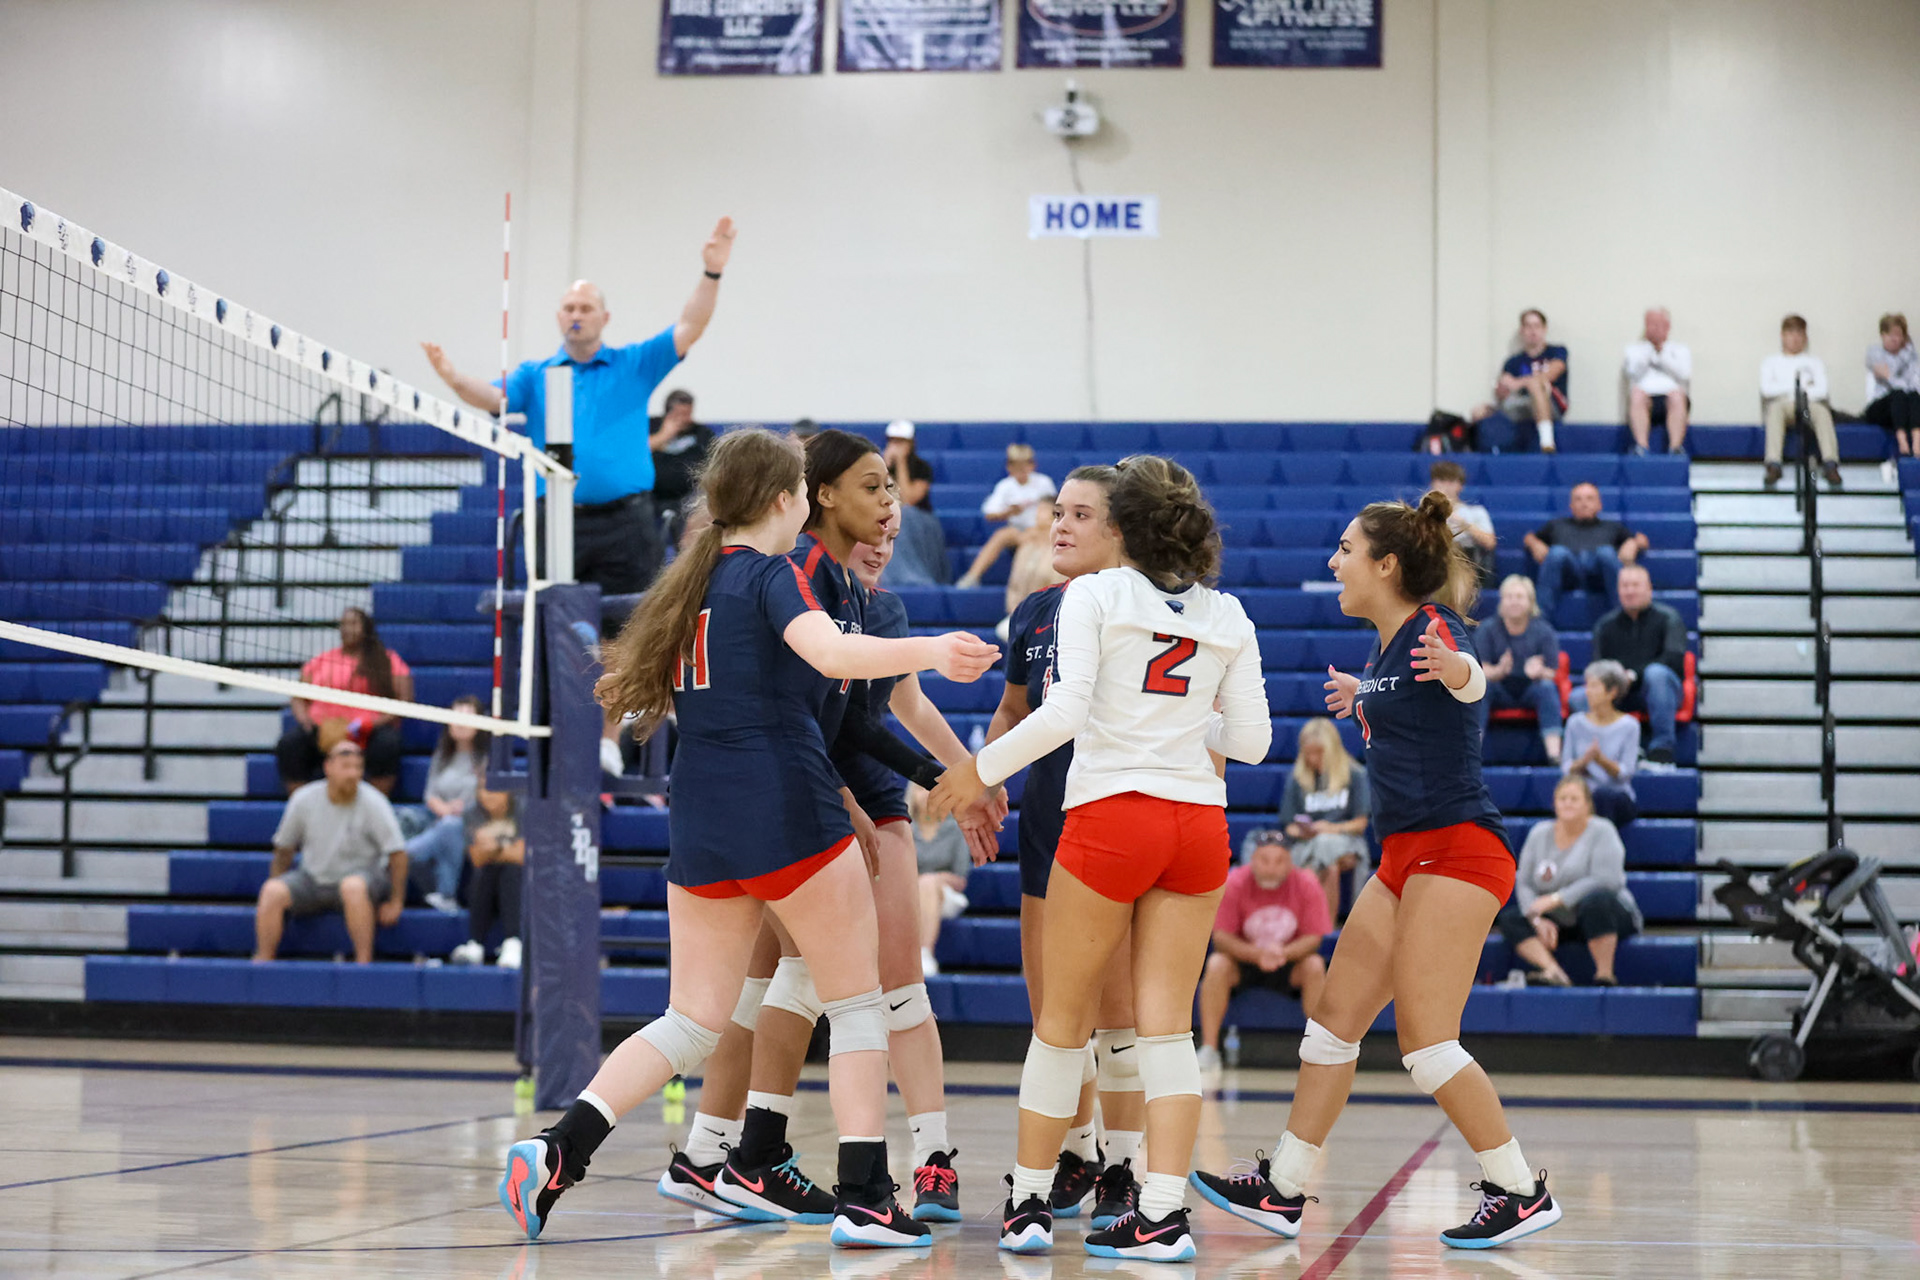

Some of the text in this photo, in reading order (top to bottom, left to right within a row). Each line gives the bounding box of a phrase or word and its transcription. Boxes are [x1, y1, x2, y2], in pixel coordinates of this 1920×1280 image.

[1045, 202, 1142, 229] HOME
[1025, 645, 1042, 662] ST.
[1141, 632, 1198, 697] 2
